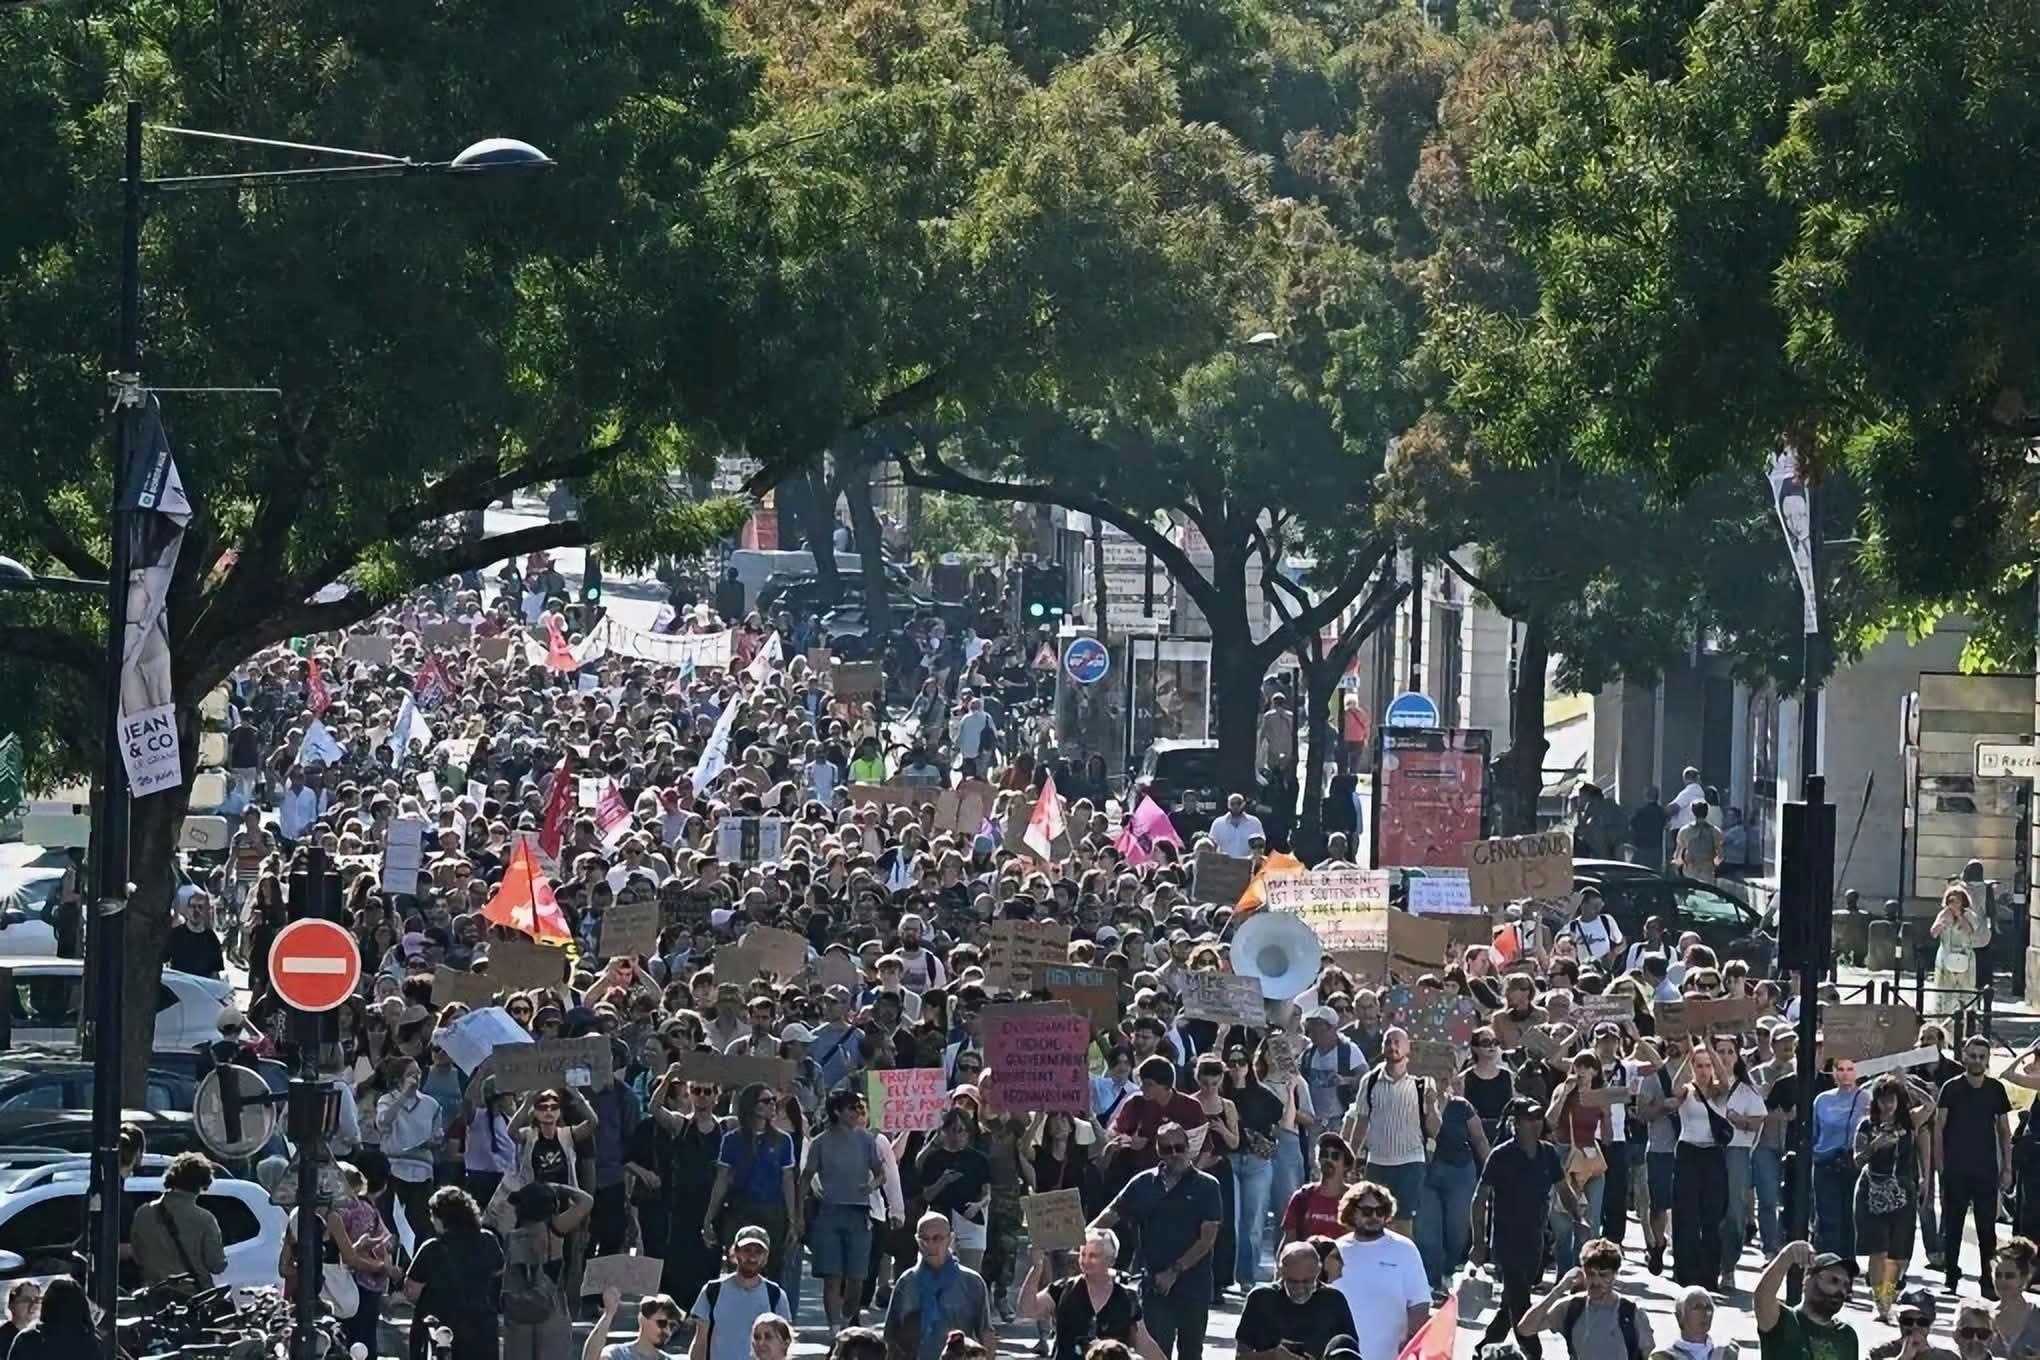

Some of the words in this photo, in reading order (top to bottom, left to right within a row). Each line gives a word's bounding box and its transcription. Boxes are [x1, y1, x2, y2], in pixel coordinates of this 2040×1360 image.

[124, 714, 168, 744] JEAN
[129, 743, 142, 758] &
[147, 733, 173, 751] CO
[1271, 891, 1287, 905] EST
[1294, 889, 1304, 901] DE
[1360, 886, 1381, 899] MES
